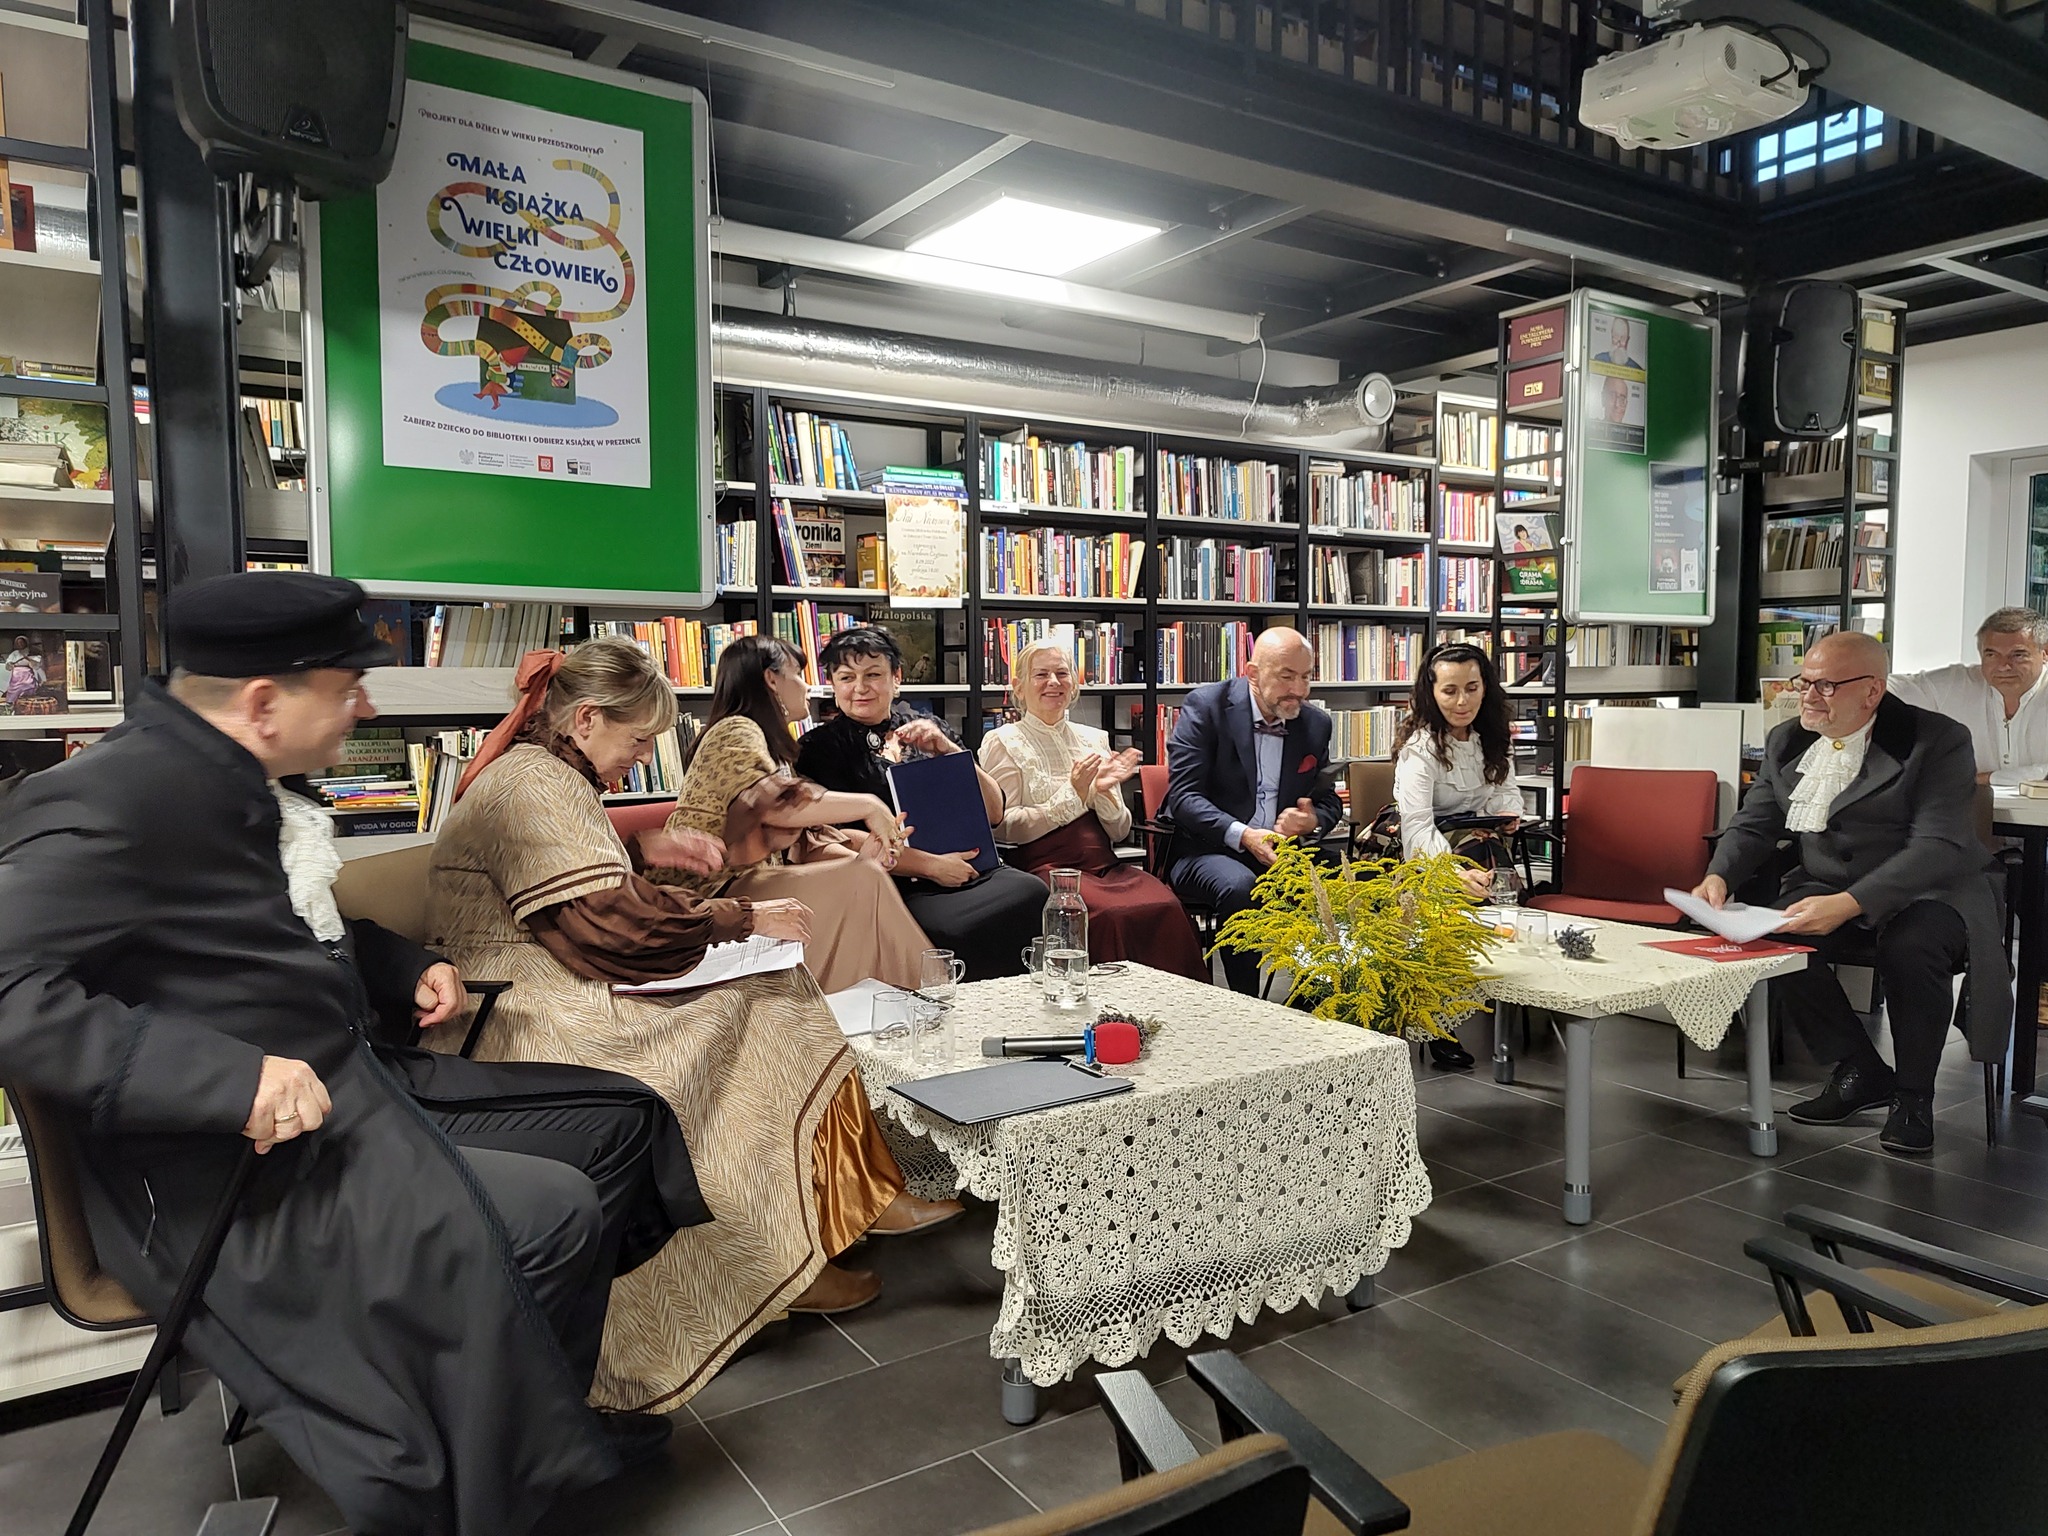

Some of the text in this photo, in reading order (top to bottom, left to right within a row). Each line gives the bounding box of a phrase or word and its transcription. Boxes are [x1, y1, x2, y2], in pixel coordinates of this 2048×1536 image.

[418, 108, 604, 155] PROJEKT DLA DZIECI W WIEKU PRZEDSZKOLNYM
[446, 152, 527, 185] MAŁA
[485, 186, 584, 225] KSIĄŻKA
[440, 197, 539, 250] WIELKI
[493, 251, 618, 294] CZŁOWIEK
[403, 415, 436, 429] ZABIERZ
[437, 422, 471, 435] DZIECKO
[472, 429, 485, 437] DO
[486, 430, 527, 442] BIBLIOTEKI
[533, 436, 564, 446] ODBIERZ
[565, 438, 596, 448] KSIĄŻKĘ
[605, 437, 642, 447] PREZENCIE
[796, 523, 842, 543] ronika
[805, 541, 822, 549] Ziemi
[0, 588, 48, 600] radycyjna
[389, 820, 417, 829] OGROD
